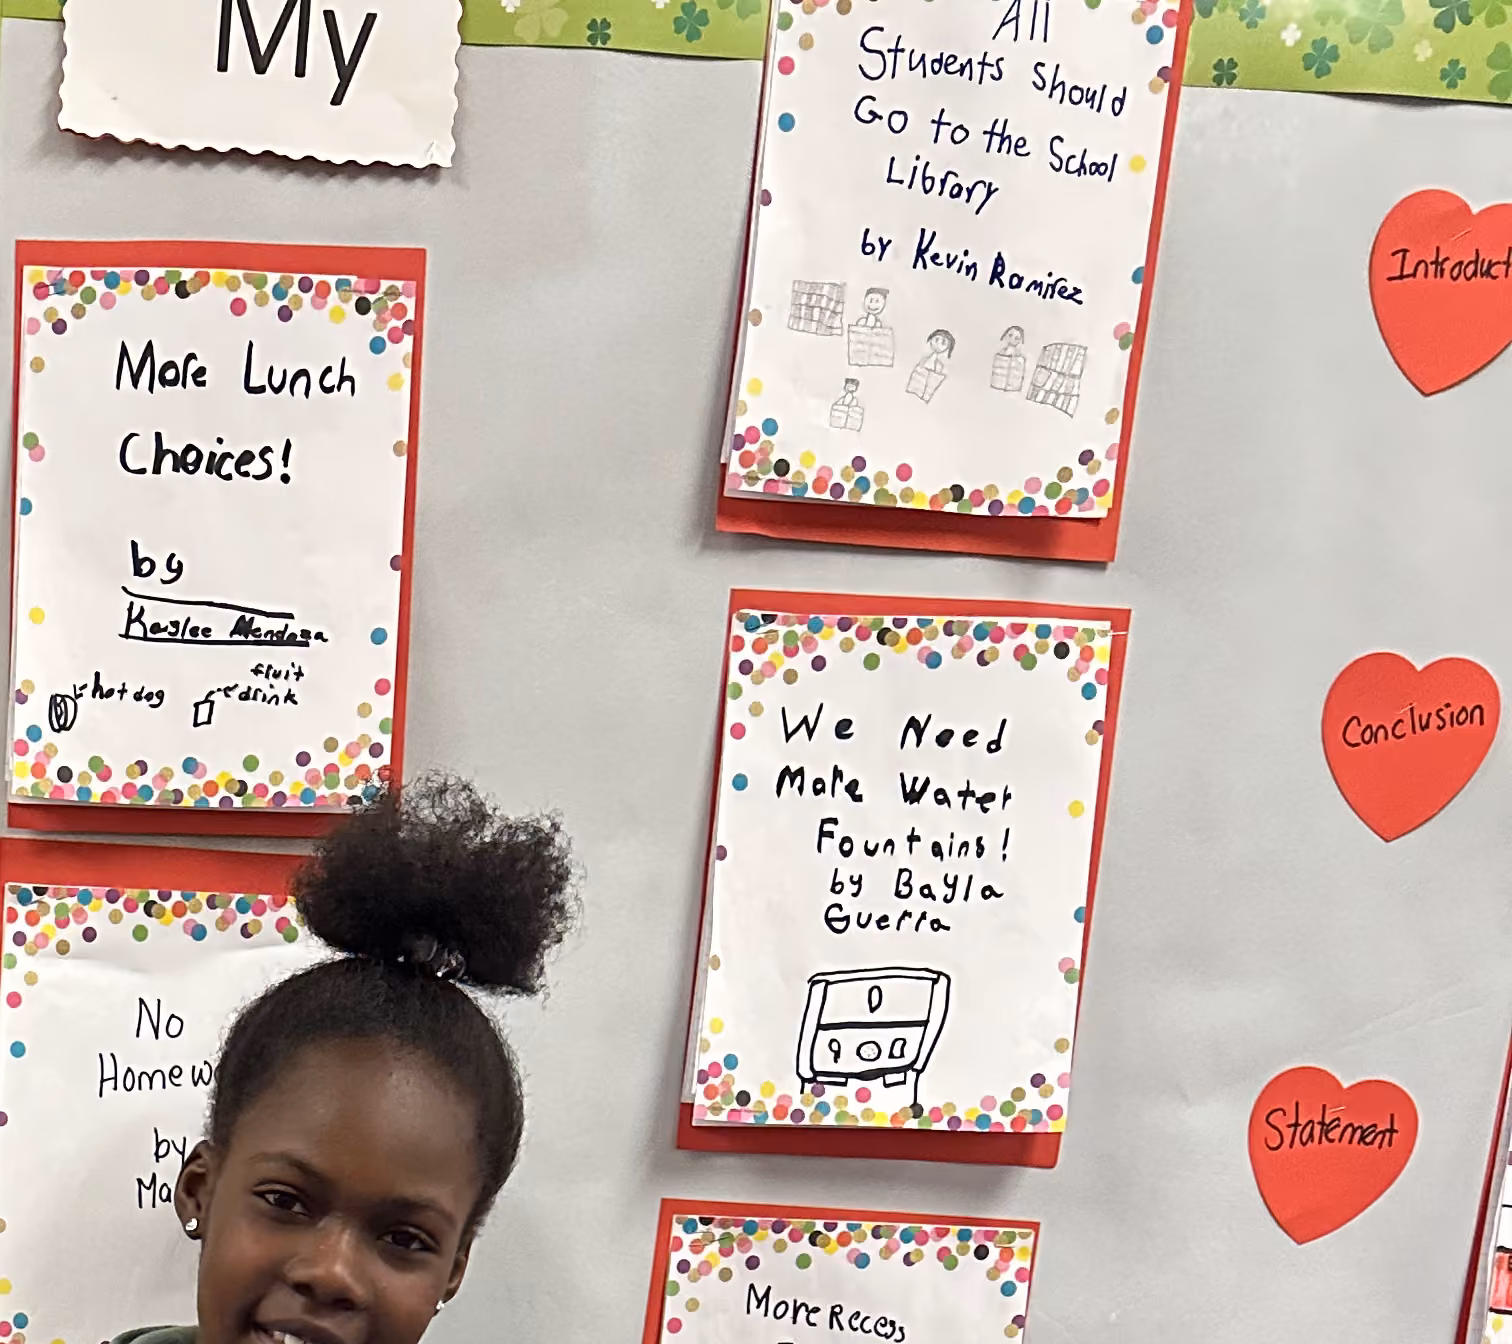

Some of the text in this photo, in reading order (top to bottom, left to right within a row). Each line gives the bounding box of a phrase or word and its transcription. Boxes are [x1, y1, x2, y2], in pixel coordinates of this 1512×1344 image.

[992, 0, 1050, 43] All
[217, 0, 379, 106] My
[858, 26, 1004, 84] Students
[854, 95, 1119, 183] Go to the School
[887, 156, 1000, 215] Library
[861, 228, 1084, 306] by Kevin Ramirez
[115, 339, 358, 399] More Lunch
[120, 431, 293, 484] Choices!
[131, 541, 185, 585] by
[91, 671, 165, 708] hot dog
[782, 703, 1007, 754] We Need
[1341, 701, 1486, 749] Conclusion
[776, 764, 1012, 813] More Water
[830, 868, 862, 897] by
[824, 904, 951, 934] Guerra
[136, 997, 184, 1040] No
[97, 1053, 218, 1098] Homew
[154, 1127, 187, 1169] by
[1263, 1104, 1400, 1153] Statement
[746, 1283, 906, 1344] More Recess
